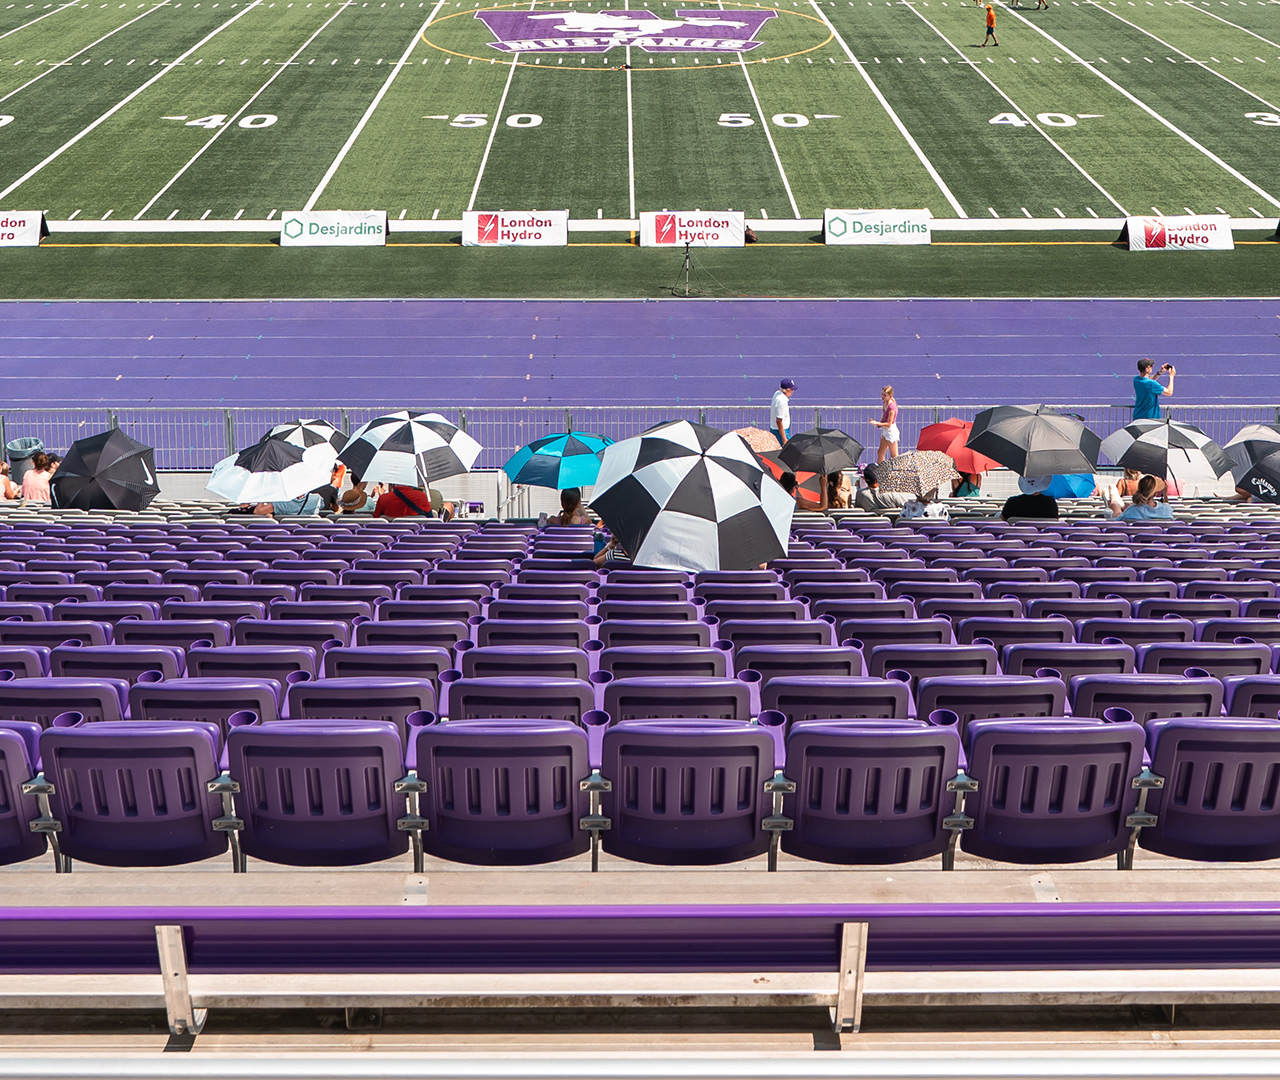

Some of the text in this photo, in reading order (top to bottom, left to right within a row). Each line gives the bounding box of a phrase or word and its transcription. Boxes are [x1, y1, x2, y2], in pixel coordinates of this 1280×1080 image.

[508, 37, 745, 49] MUSTANGS
[185, 115, 278, 128] 40
[449, 115, 543, 128] 50
[717, 114, 809, 127] 50
[989, 114, 1077, 127] 40
[308, 220, 383, 236] Desjardins
[501, 218, 552, 228] London
[678, 218, 729, 228] London
[852, 220, 927, 236] Desjardins
[501, 229, 542, 242] Hydro
[679, 230, 720, 243] Hydro
[1169, 233, 1209, 246] Hydro
[1251, 477, 1277, 497] Callaway
